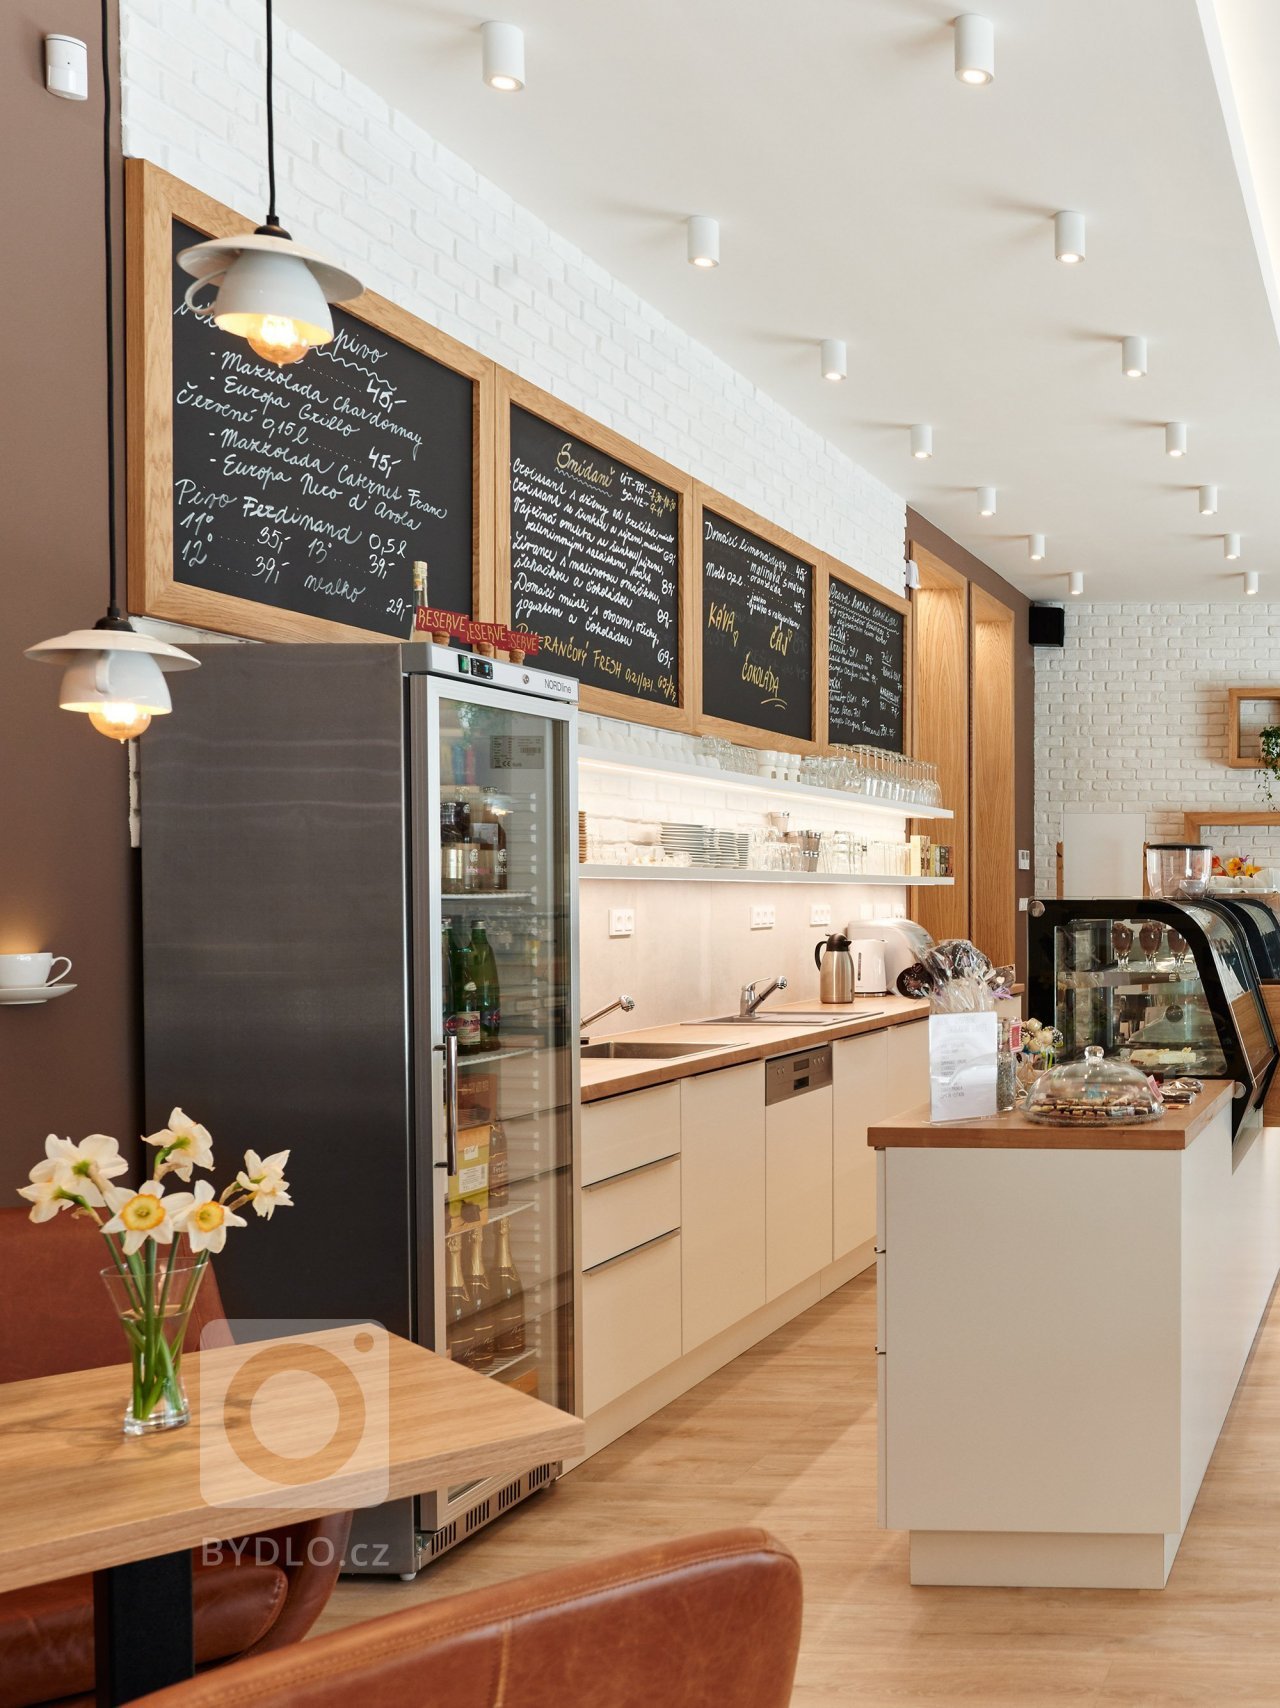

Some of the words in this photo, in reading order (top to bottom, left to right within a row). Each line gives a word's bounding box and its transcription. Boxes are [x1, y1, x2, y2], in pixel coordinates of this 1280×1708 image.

[333, 328, 388, 364] pivo
[176, 381, 257, 423] Červené
[221, 350, 329, 404] Mazzolada
[333, 396, 423, 460] Chardonnay
[224, 376, 291, 415] Europa
[221, 428, 335, 474] Mazzolada
[223, 454, 292, 490] Europa
[512, 457, 567, 495] Croissant
[512, 477, 562, 508] Croissant
[175, 479, 238, 508] Pivo
[242, 496, 362, 545] Ferdinand
[707, 601, 735, 633] KÁVA
[769, 625, 789, 657] ČAJ
[544, 678, 572, 694] NORDline
[741, 651, 780, 698] ČOKOLÁDA
